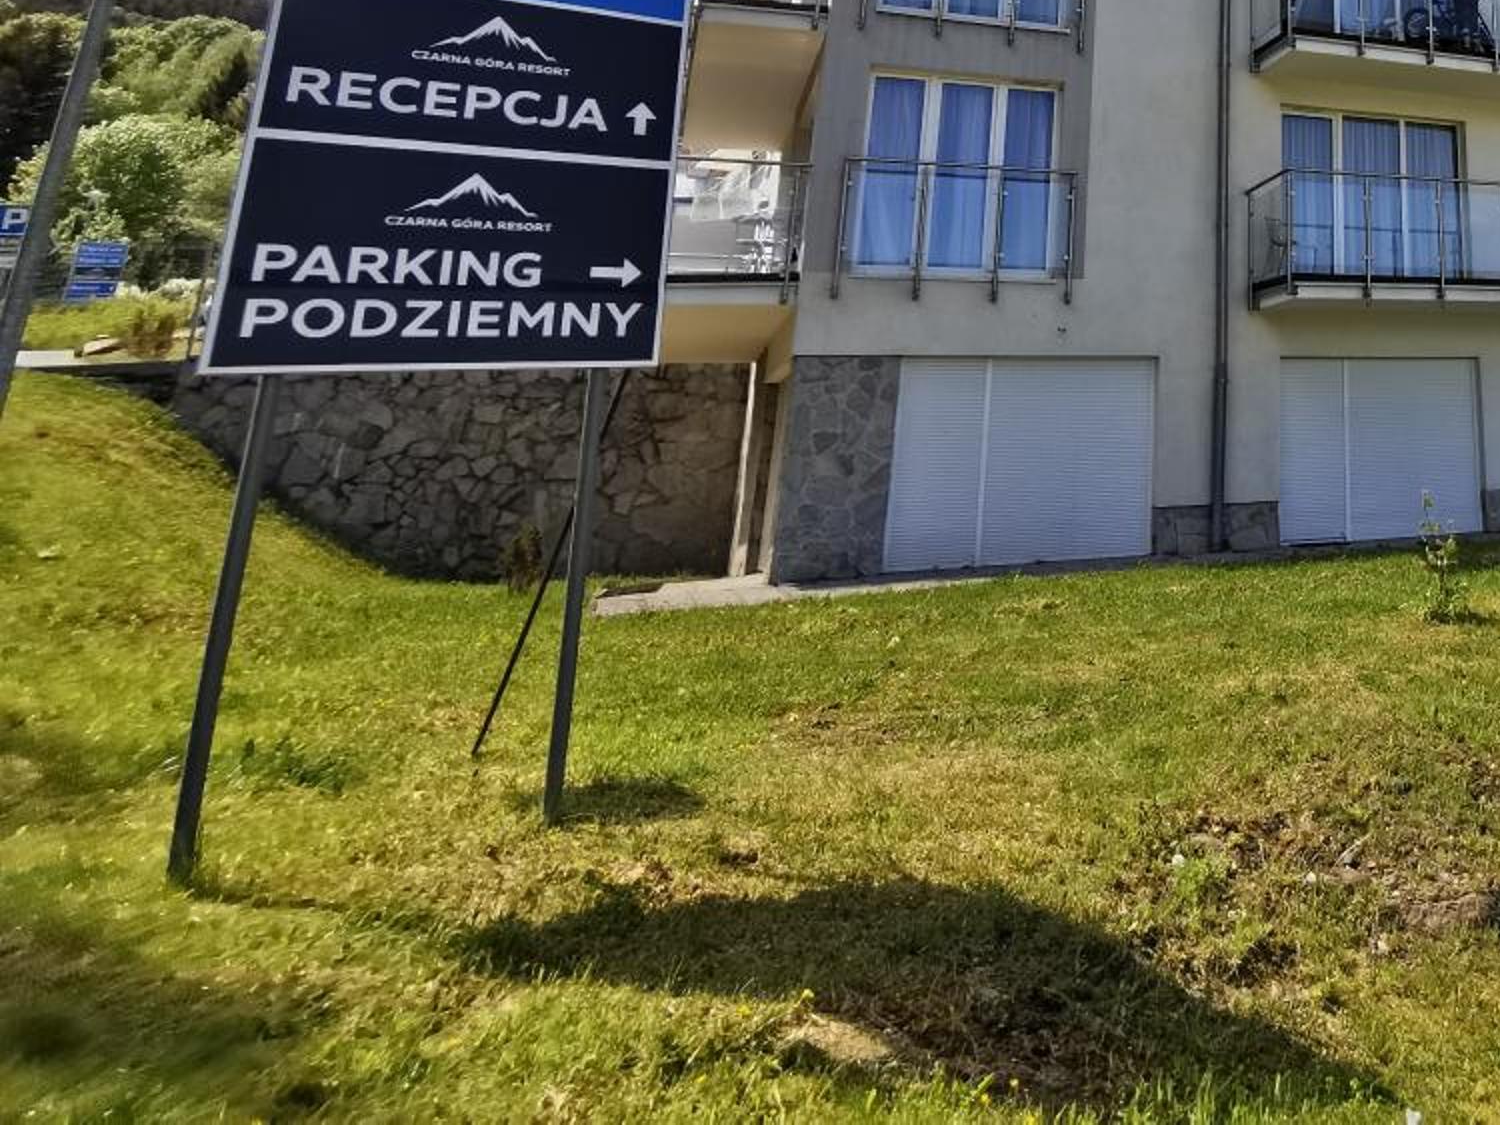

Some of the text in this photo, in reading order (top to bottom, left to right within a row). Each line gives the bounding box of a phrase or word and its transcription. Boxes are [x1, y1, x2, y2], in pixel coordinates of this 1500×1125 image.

[411, 50, 571, 76] CZARNA GÓRA RESORT
[285, 66, 608, 132] RECEPCJA
[384, 215, 552, 232] CZARNA GÓRA RESORT
[250, 243, 542, 288] PARKING
[239, 297, 643, 339] PODZIEMNY
